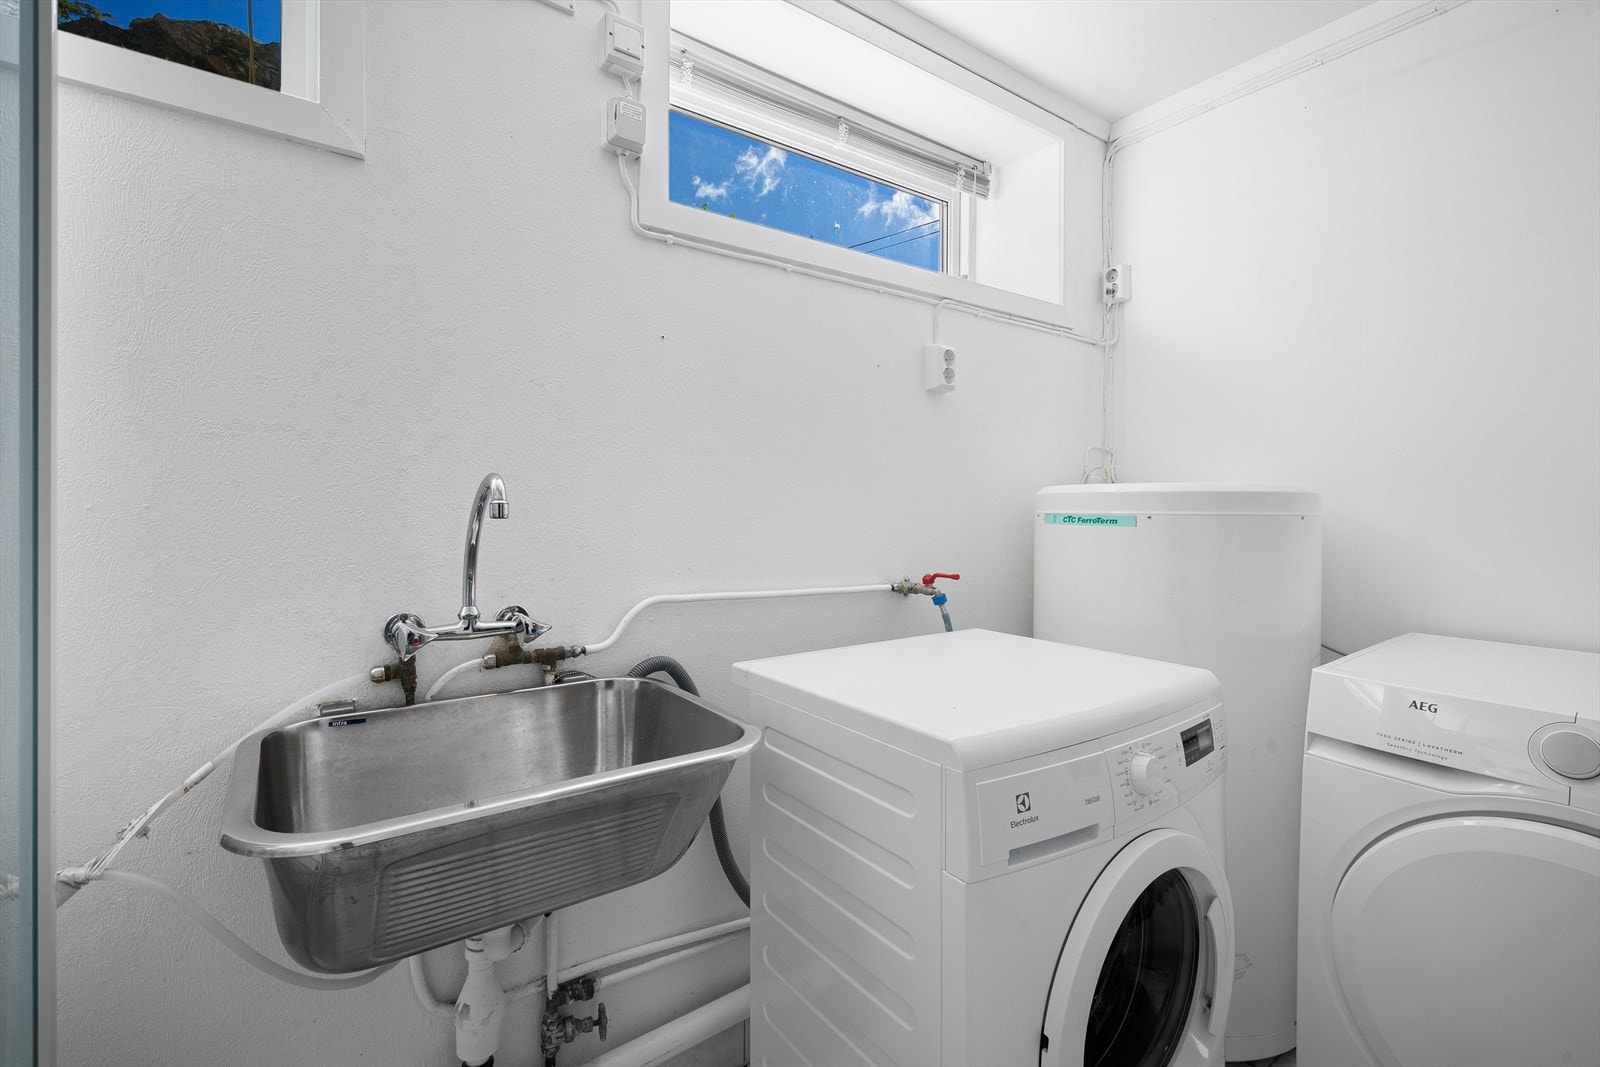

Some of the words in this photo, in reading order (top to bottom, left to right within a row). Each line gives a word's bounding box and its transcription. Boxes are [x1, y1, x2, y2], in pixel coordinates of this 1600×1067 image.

[1062, 515, 1076, 523] CTC
[1077, 516, 1118, 525] FerroTerm
[1408, 700, 1438, 714] AEG
[1394, 736, 1416, 745] SERIES
[1422, 743, 1463, 755] LAVATHERM
[1010, 815, 1039, 828] Electrolux
